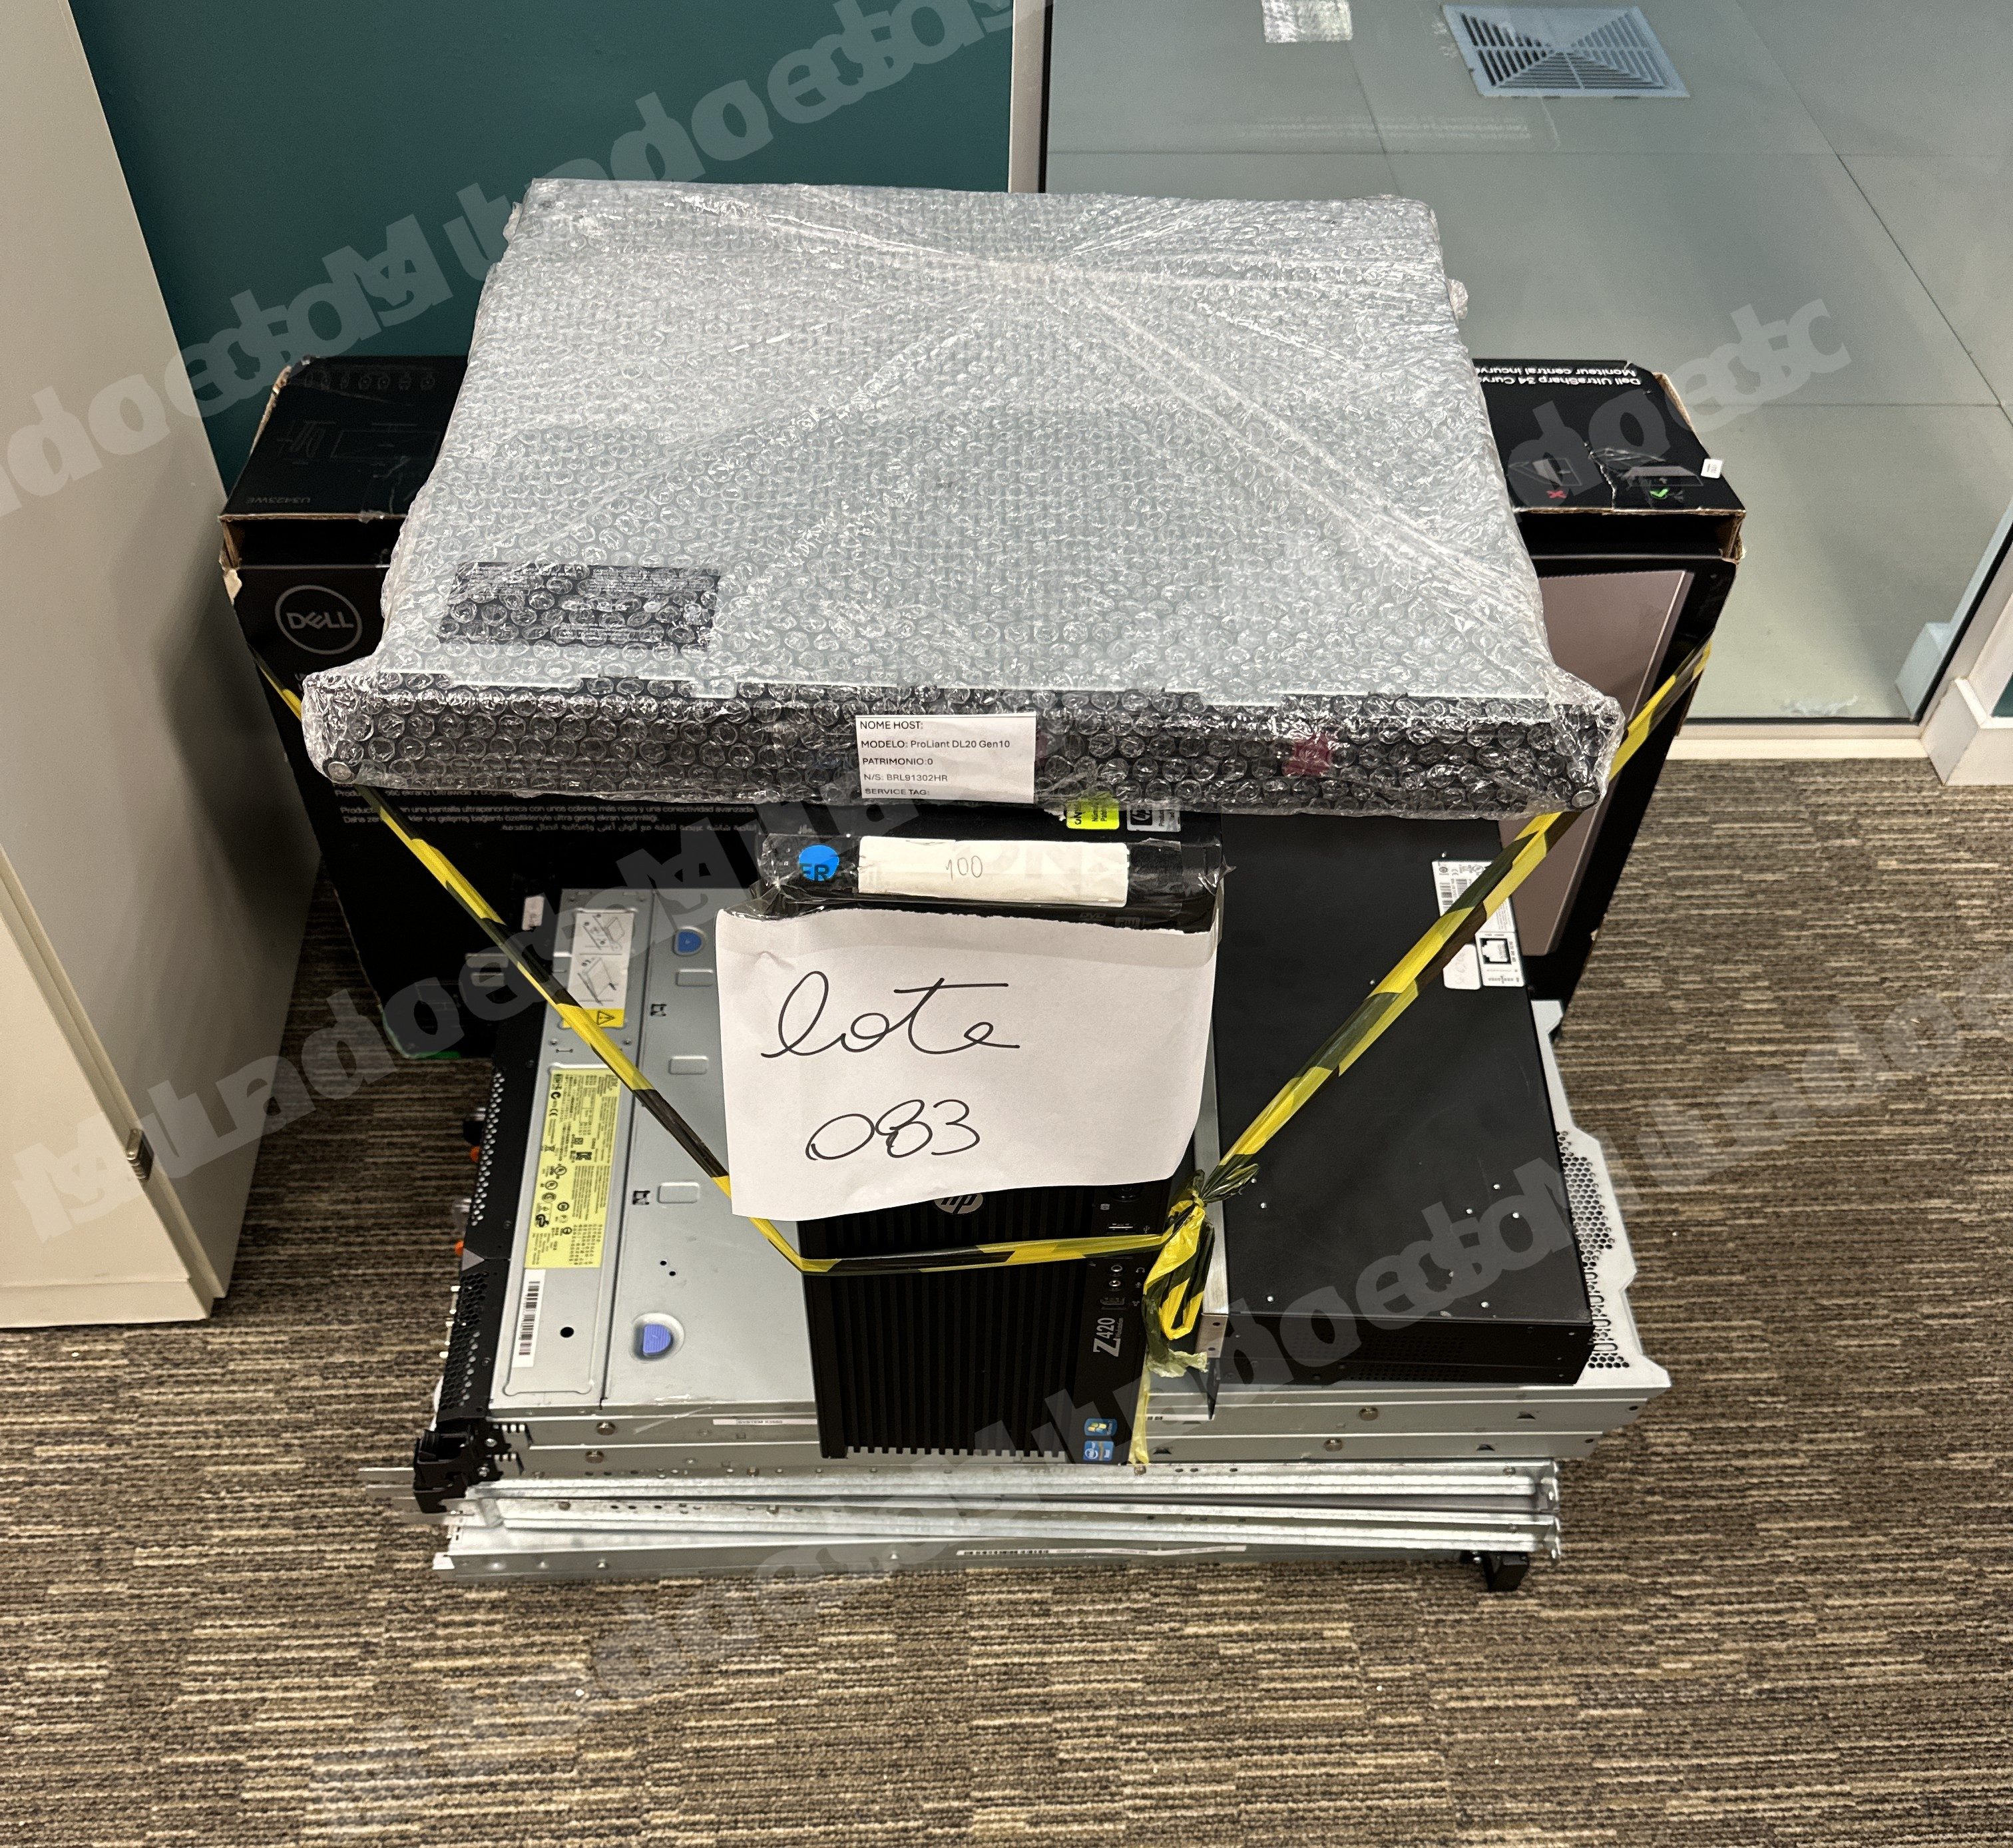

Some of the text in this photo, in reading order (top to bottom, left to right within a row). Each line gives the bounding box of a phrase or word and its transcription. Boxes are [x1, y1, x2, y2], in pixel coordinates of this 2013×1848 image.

[1538, 375, 1612, 385] UltraSharp
[1575, 368, 1636, 377] Moniteur
[286, 610, 354, 630] DELL
[860, 720, 924, 730] NOME HOST:
[861, 740, 909, 749] MODELO:
[911, 740, 950, 749] ProLiant
[945, 855, 983, 881] 100
[760, 971, 1021, 1058] lote
[805, 1099, 980, 1162] 083
[1092, 1317, 1122, 1357] Z420
